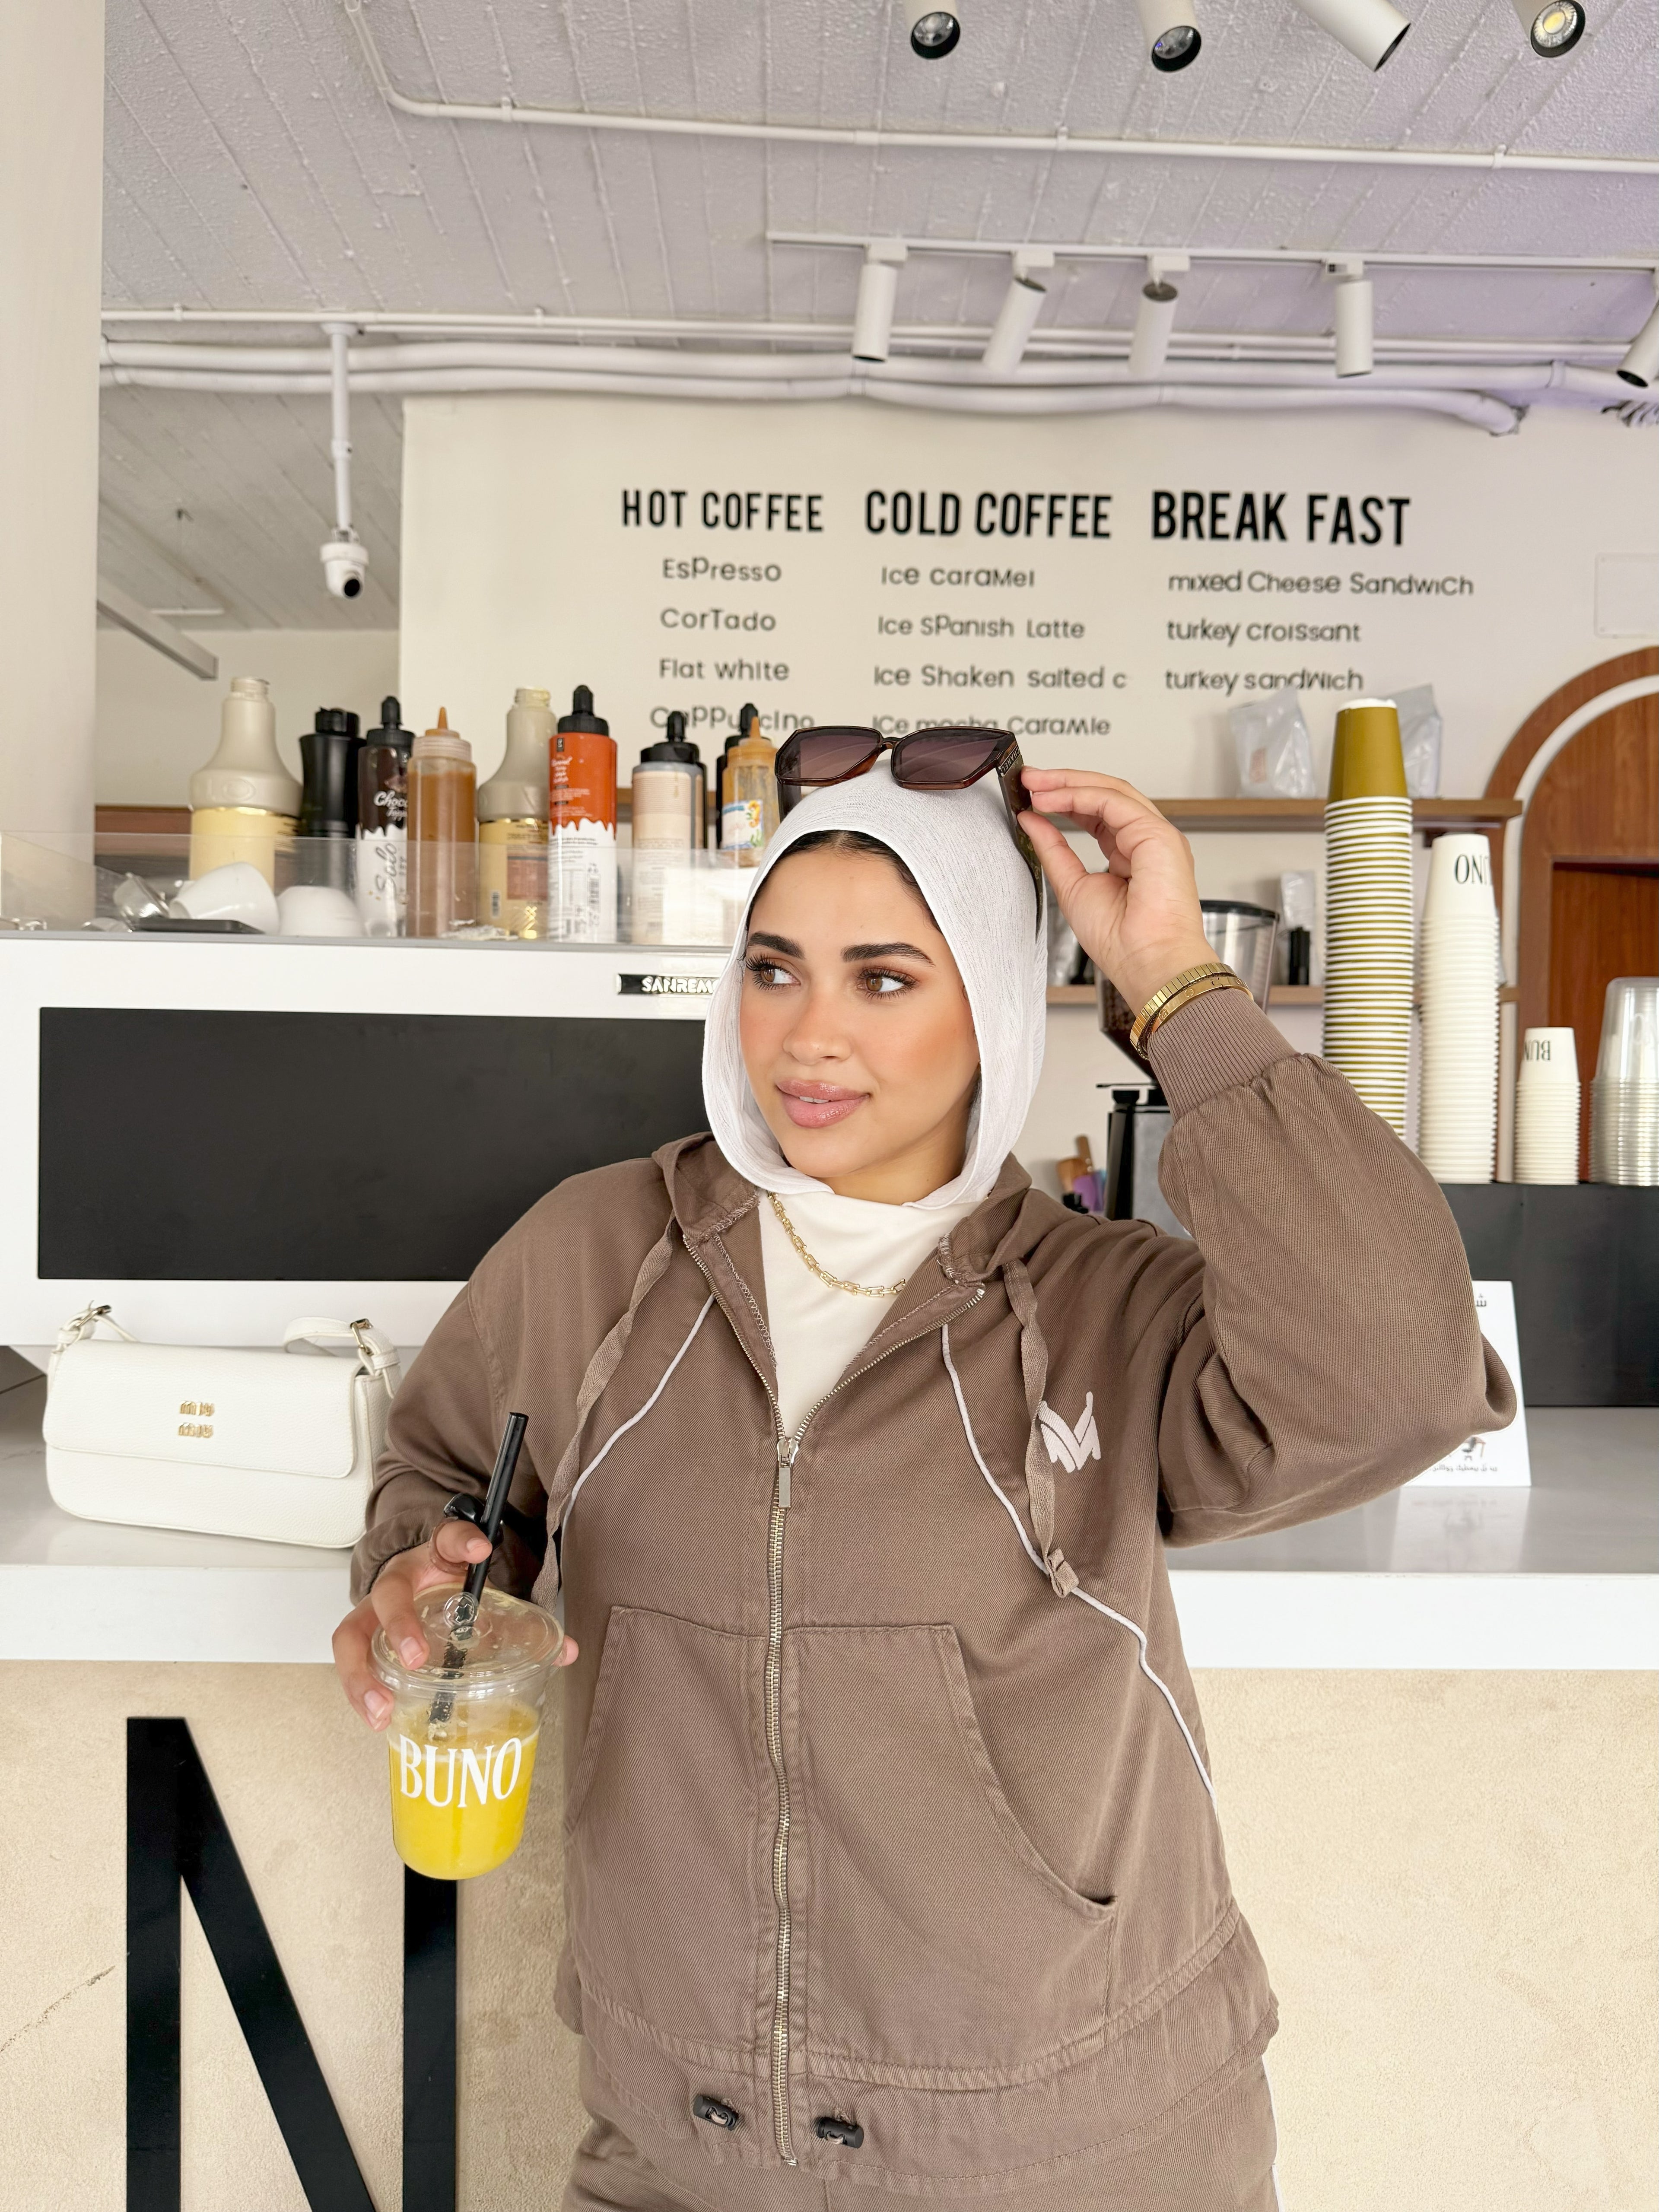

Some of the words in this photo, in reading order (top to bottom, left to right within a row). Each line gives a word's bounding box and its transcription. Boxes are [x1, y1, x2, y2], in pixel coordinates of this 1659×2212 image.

[622, 489, 688, 528] HOT
[702, 491, 823, 532] COFFEE
[865, 489, 961, 537] COLD
[975, 492, 1112, 539] COFFEE
[1151, 490, 1287, 542] BREAK
[1306, 494, 1411, 546] FAST
[1167, 618, 1241, 647] turkey
[1165, 670, 1239, 697] turkey
[641, 976, 720, 993] SANREM
[399, 1734, 522, 1808] BUNO
